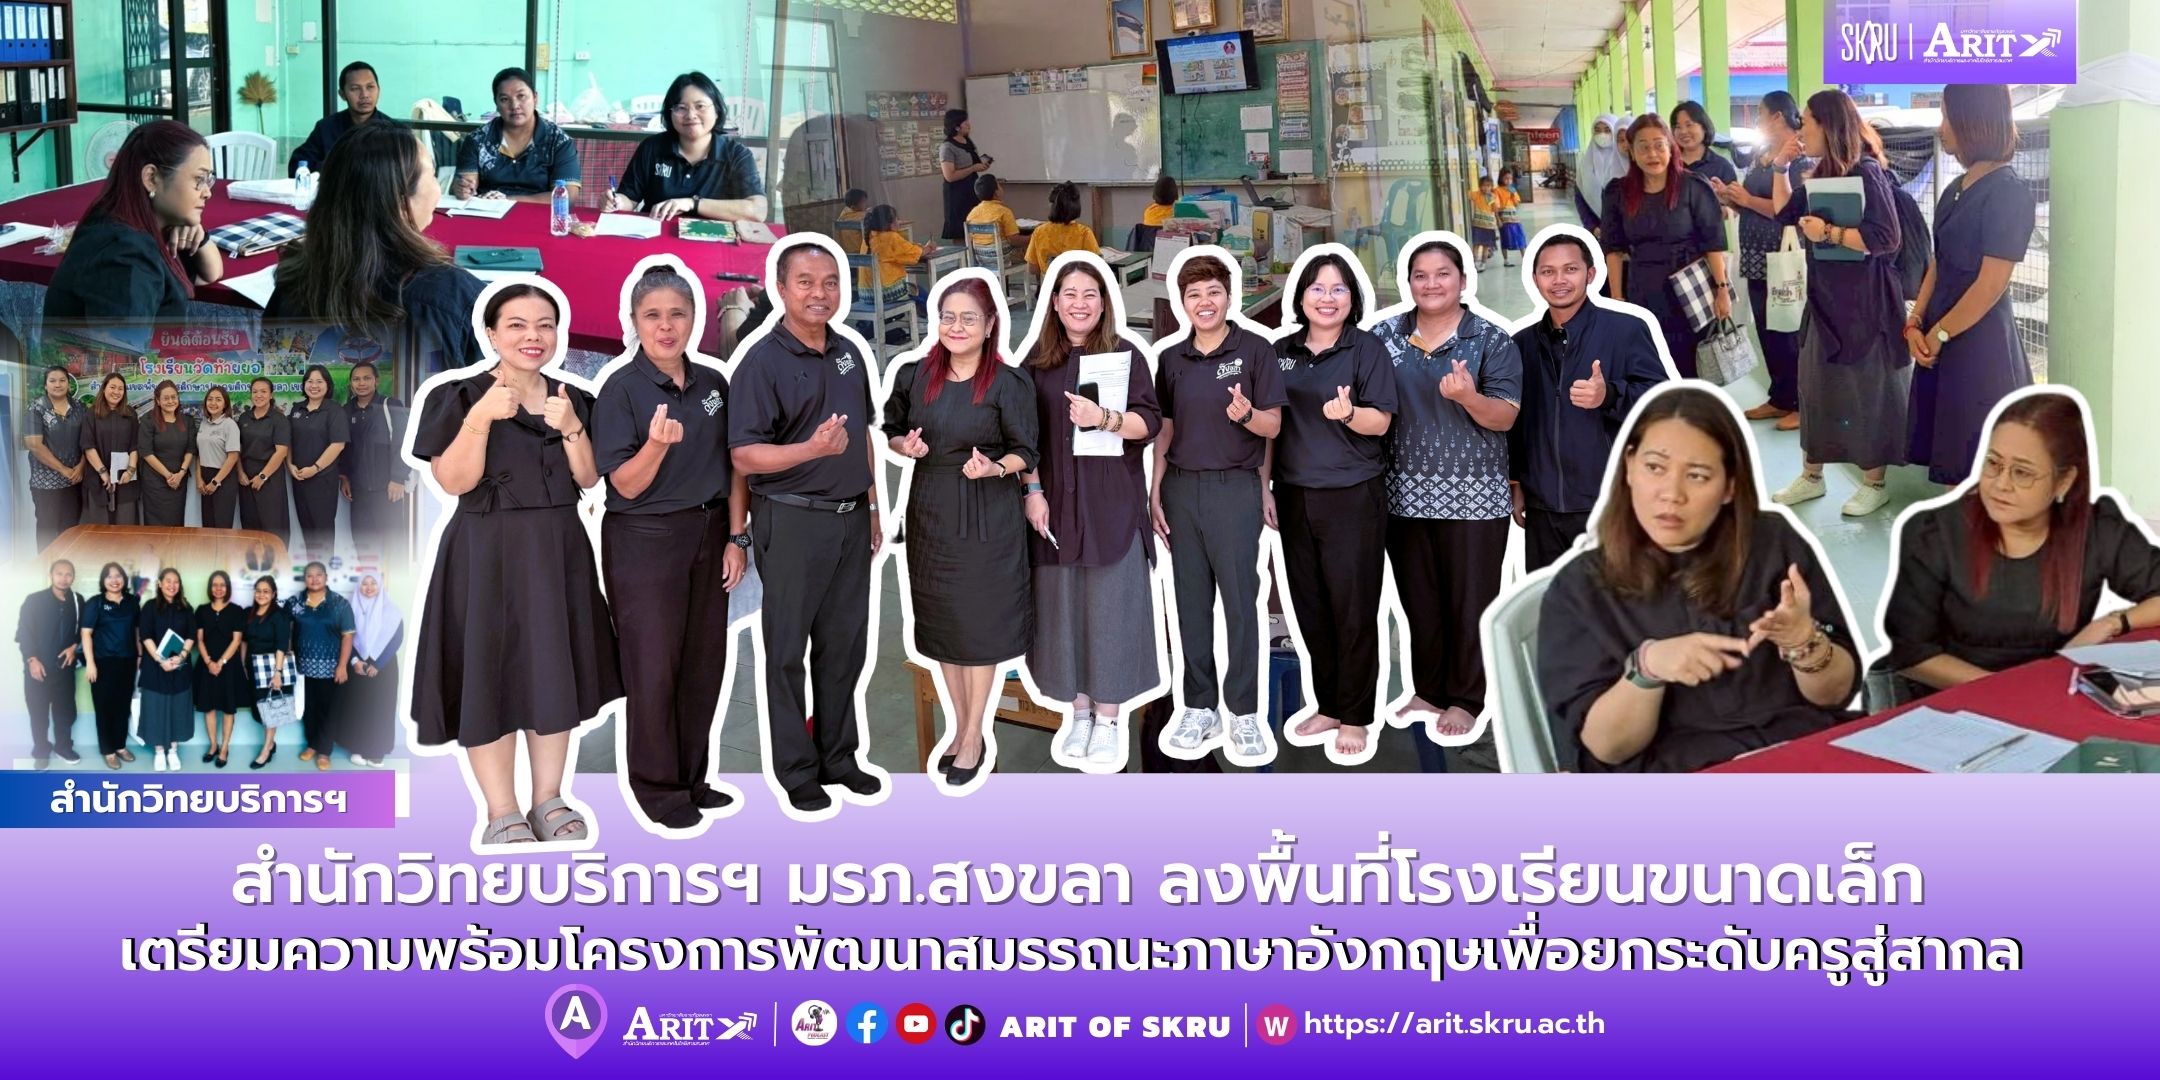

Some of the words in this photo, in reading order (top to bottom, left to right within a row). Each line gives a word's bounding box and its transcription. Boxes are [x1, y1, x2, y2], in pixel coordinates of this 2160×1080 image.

[160, 329, 241, 348] ยินดีต้อนรับ
[138, 356, 262, 376] โรงเรียนวัดท้ายยอ
